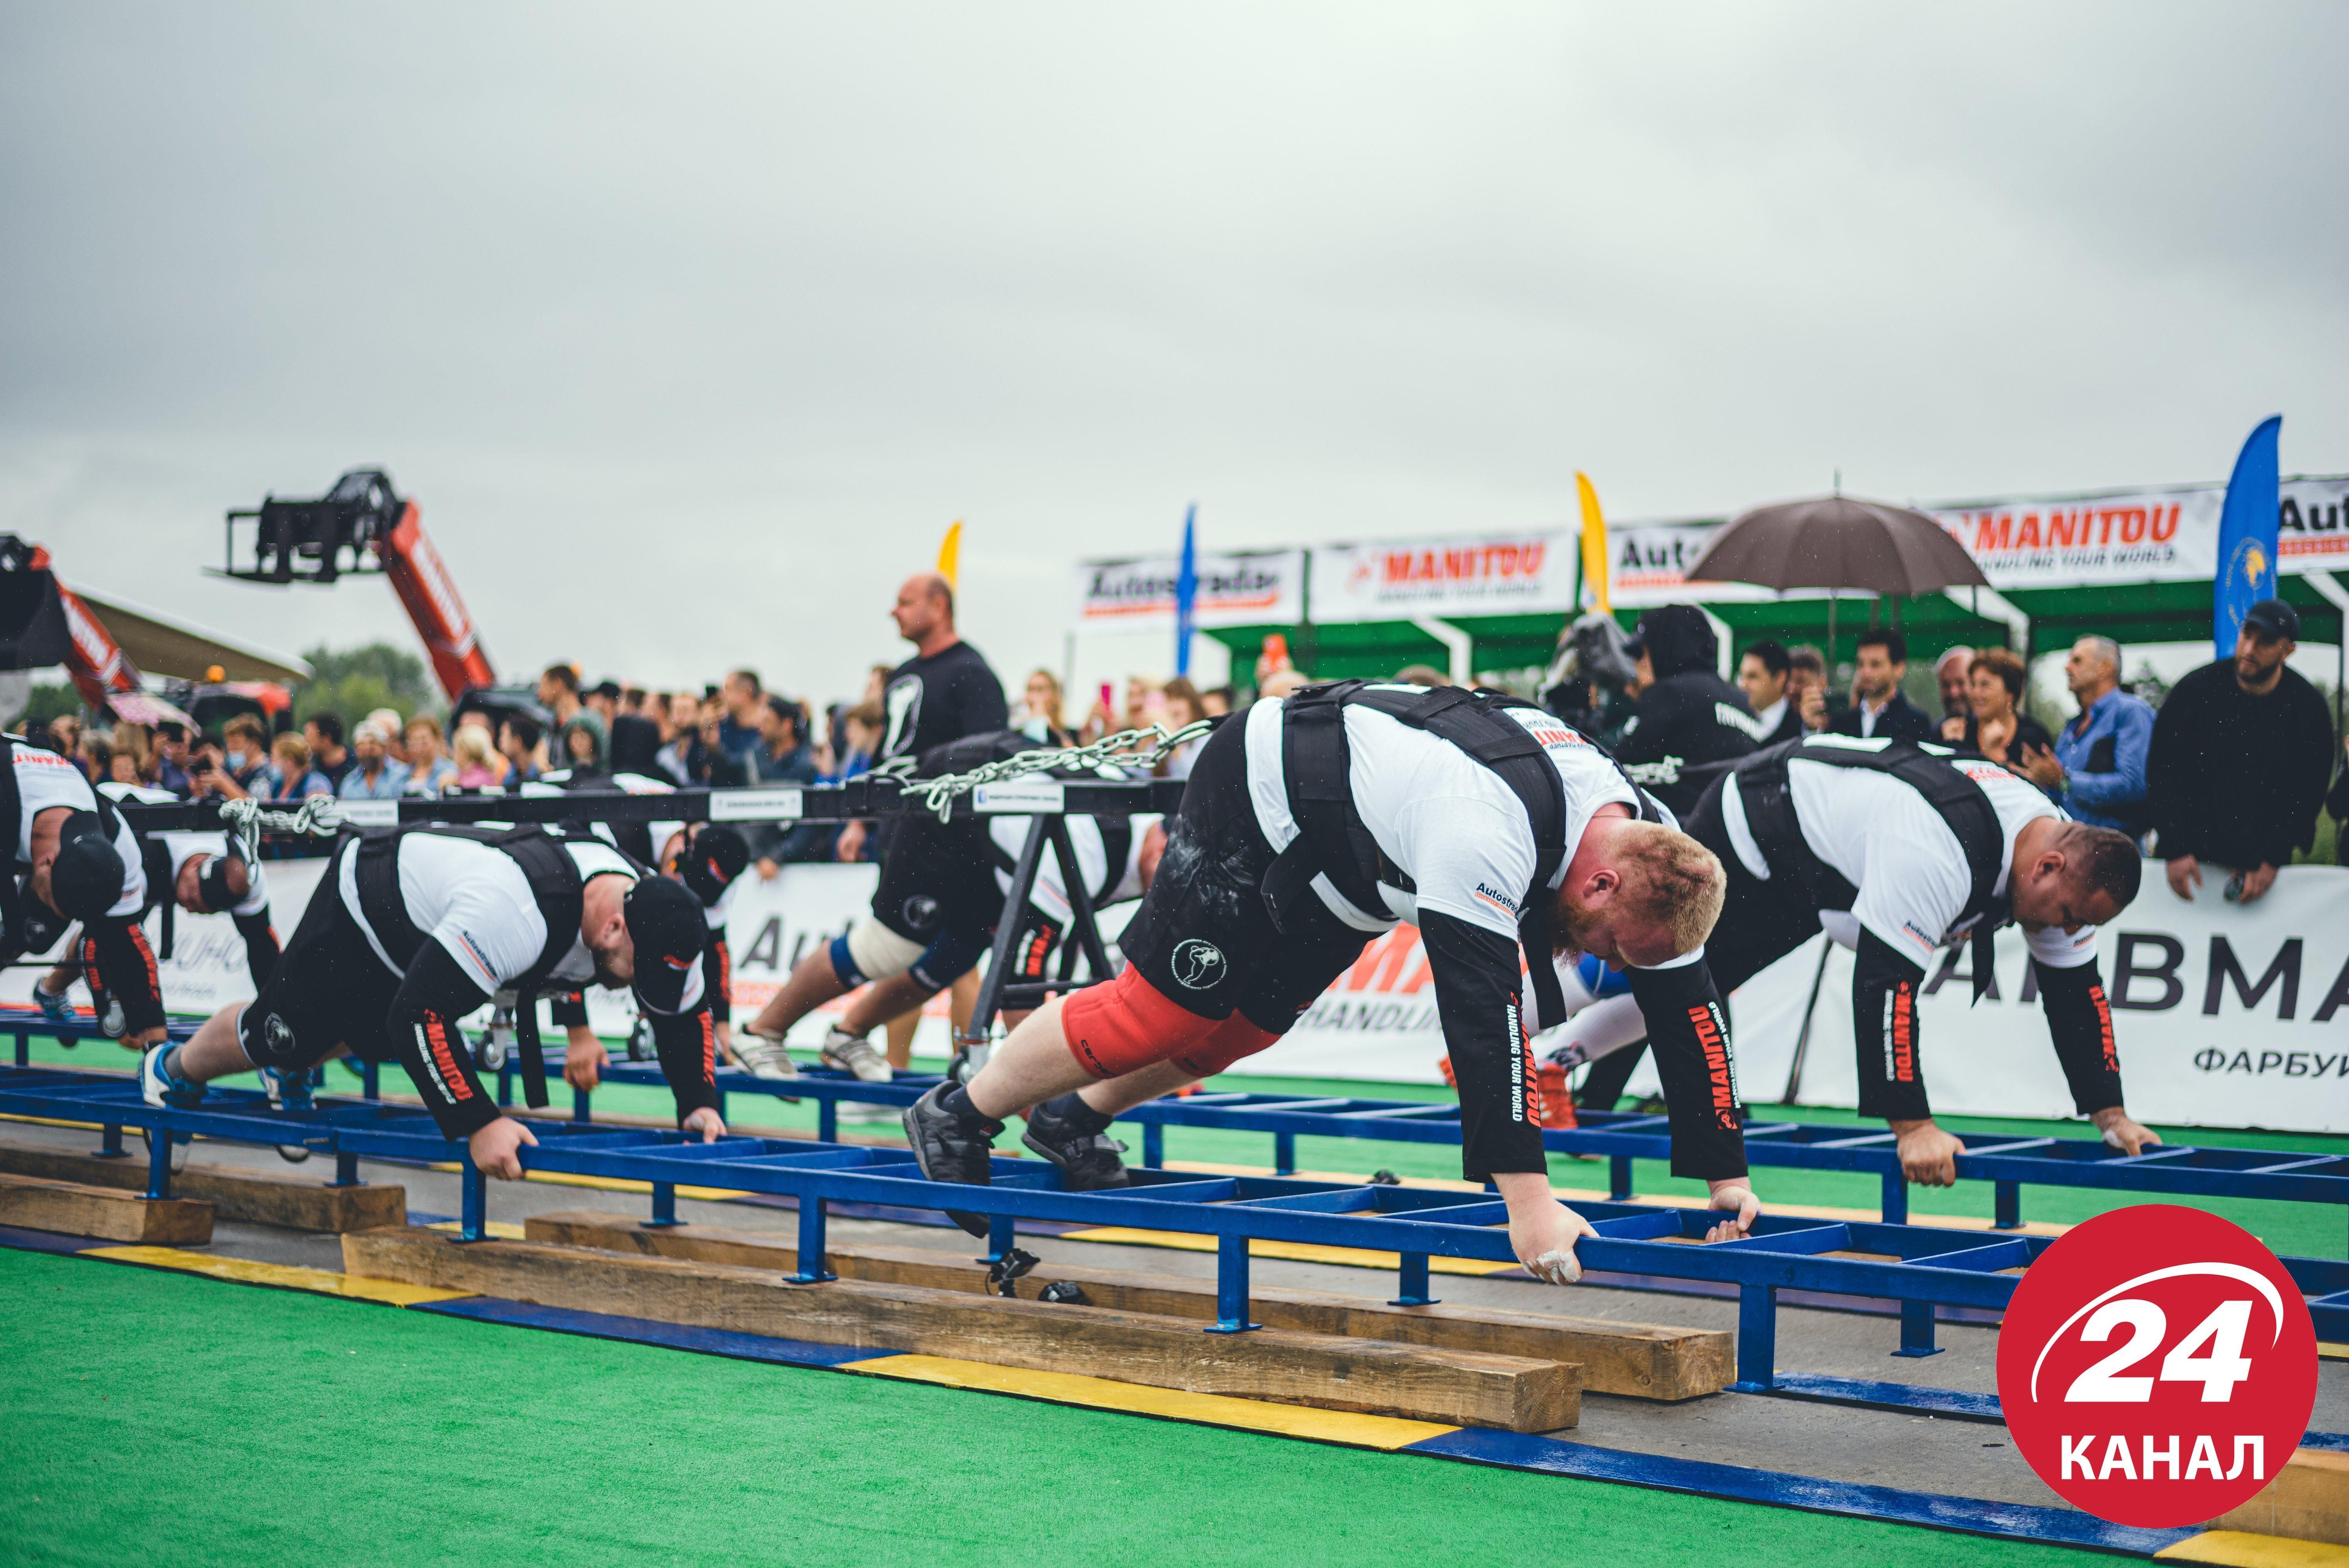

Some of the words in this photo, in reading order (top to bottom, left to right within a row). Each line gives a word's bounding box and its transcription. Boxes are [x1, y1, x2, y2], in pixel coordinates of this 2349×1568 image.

[1975, 502, 2182, 550] MANITOU
[1382, 542, 1544, 583] MANITOU
[1507, 1004, 1521, 1055] HANDLING
[1708, 1001, 1727, 1034] WORLD
[1894, 991, 1913, 1082] MANITOU
[426, 1021, 474, 1101] MANITOU
[1511, 1057, 1522, 1084] YOUR
[1519, 1009, 1542, 1128] ANITOU
[1688, 1005, 1732, 1108] MANITOU
[1723, 1033, 1732, 1060] YOUR
[1512, 1086, 1523, 1122] WORLD
[1729, 1060, 1741, 1109] HANDLING
